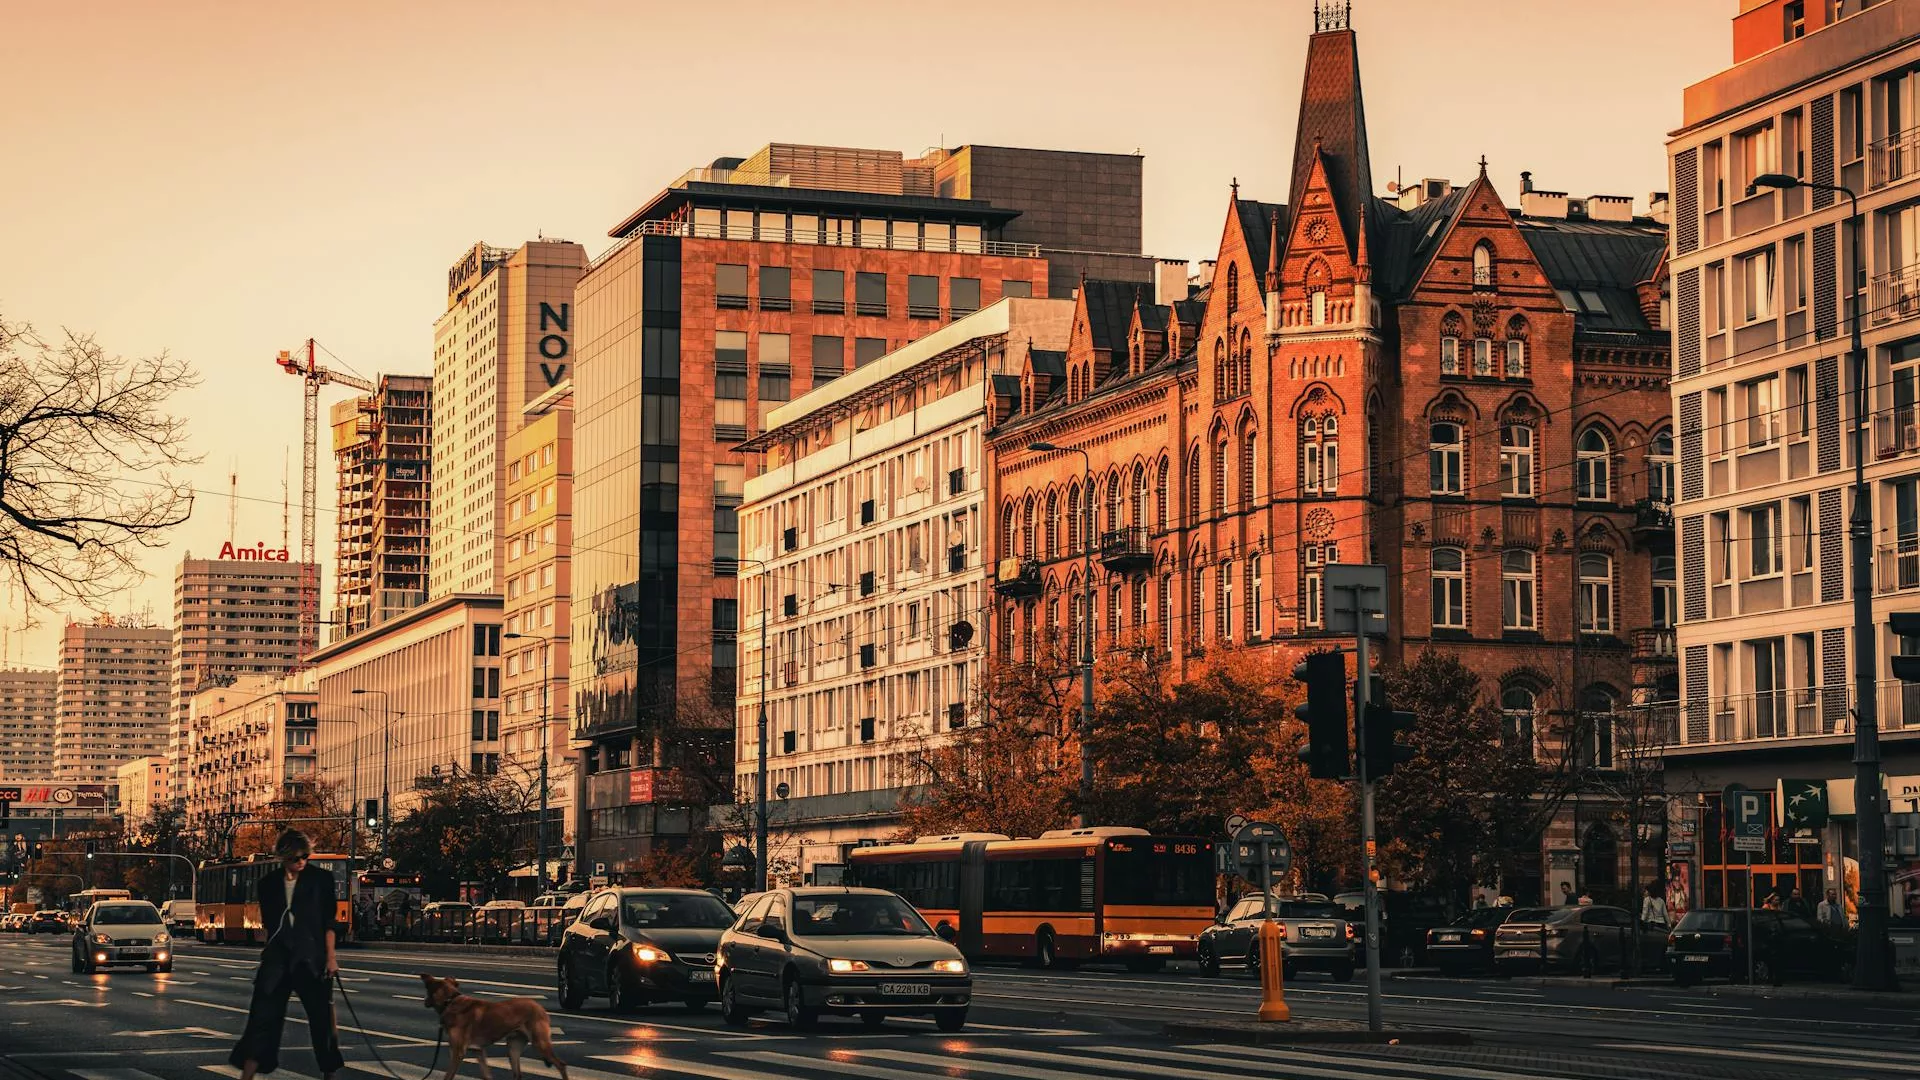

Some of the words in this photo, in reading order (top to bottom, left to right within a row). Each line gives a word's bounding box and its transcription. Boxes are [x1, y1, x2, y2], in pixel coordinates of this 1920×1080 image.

[449, 246, 479, 297] NOVOTEL
[539, 301, 569, 387] NOV
[218, 541, 289, 563] Amica
[1741, 795, 1759, 823] P
[1174, 844, 1197, 855] 8436
[595, 862, 606, 875] P
[883, 984, 895, 994] CA
[917, 985, 929, 994] KB
